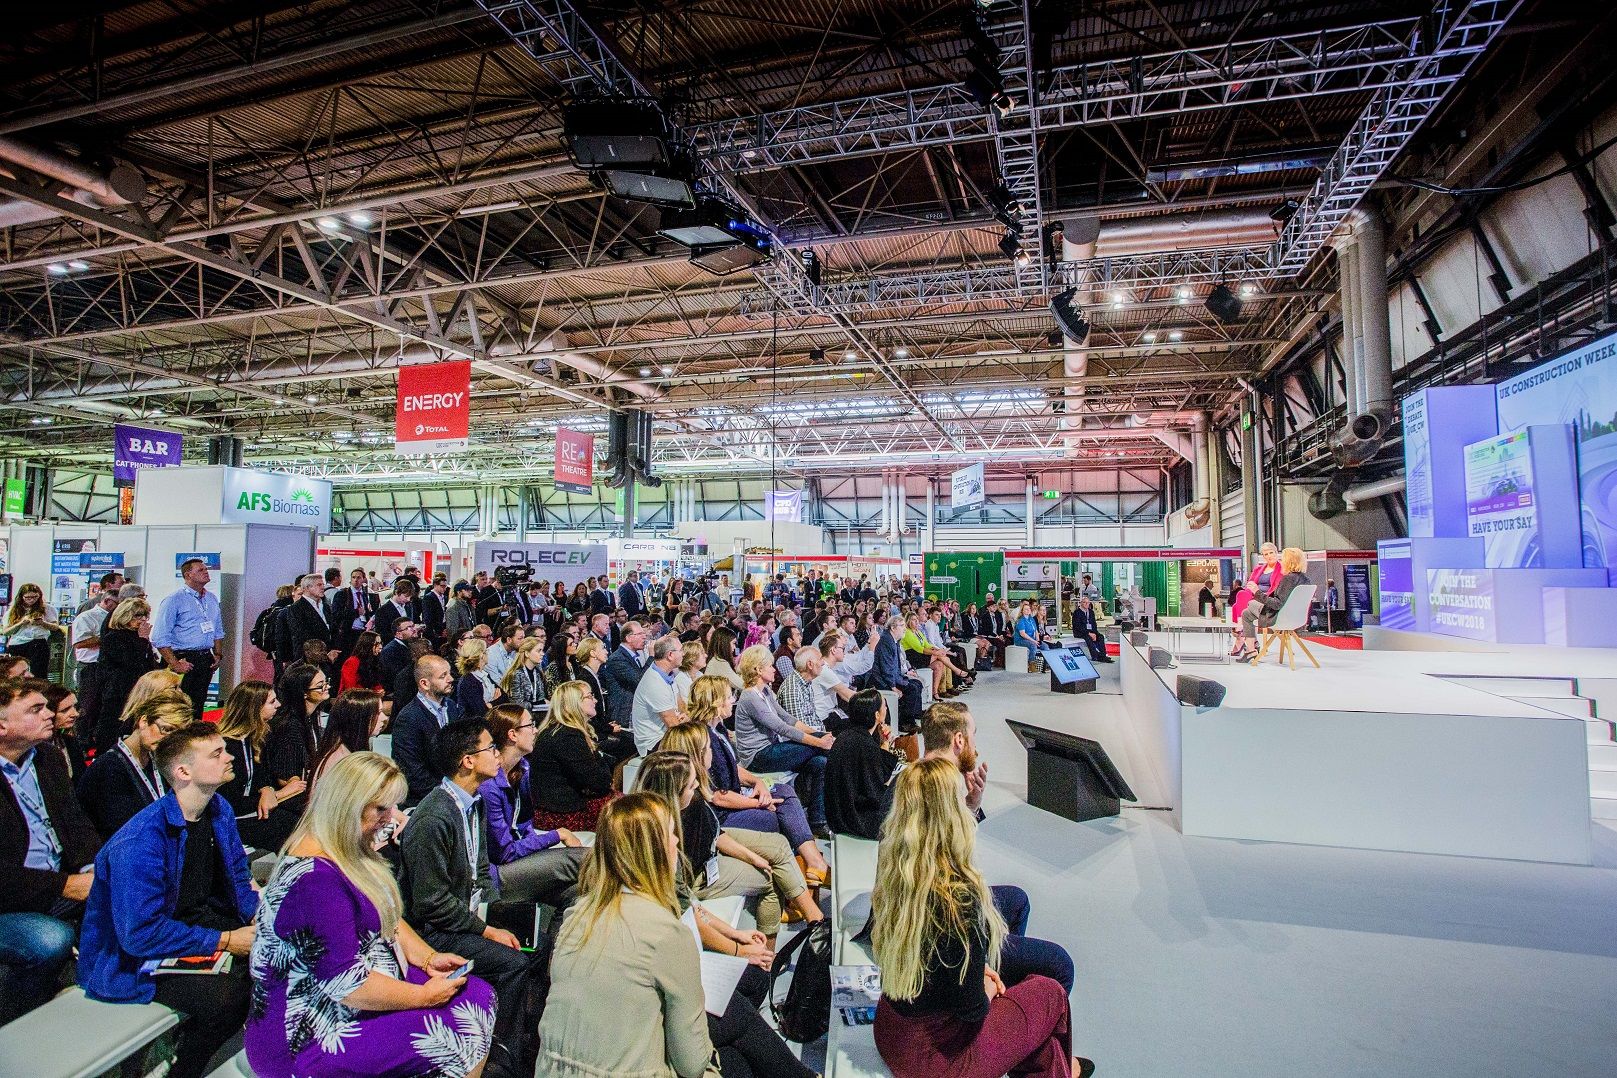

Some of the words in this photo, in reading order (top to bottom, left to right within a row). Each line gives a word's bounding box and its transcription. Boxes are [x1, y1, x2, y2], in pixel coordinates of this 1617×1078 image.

[1499, 386, 1511, 399] UK
[1511, 357, 1582, 394] CONSTRUCTION
[1583, 343, 1616, 366] WEEK
[403, 391, 464, 412] ENERGY
[1415, 398, 1424, 408] THE
[129, 437, 168, 456] BAR
[115, 459, 130, 468] CAT
[561, 464, 588, 477] THEATRE
[236, 491, 272, 512] AFS
[273, 499, 320, 516] Biomass
[1472, 520, 1491, 534] HAVE
[1491, 517, 1515, 532] YOUR
[1516, 515, 1532, 529] SAY
[1440, 574, 1458, 588] JOIN
[1459, 575, 1477, 588] THE
[1429, 593, 1492, 610] CONVERSATION
[1435, 612, 1485, 630] #UKCW2018
